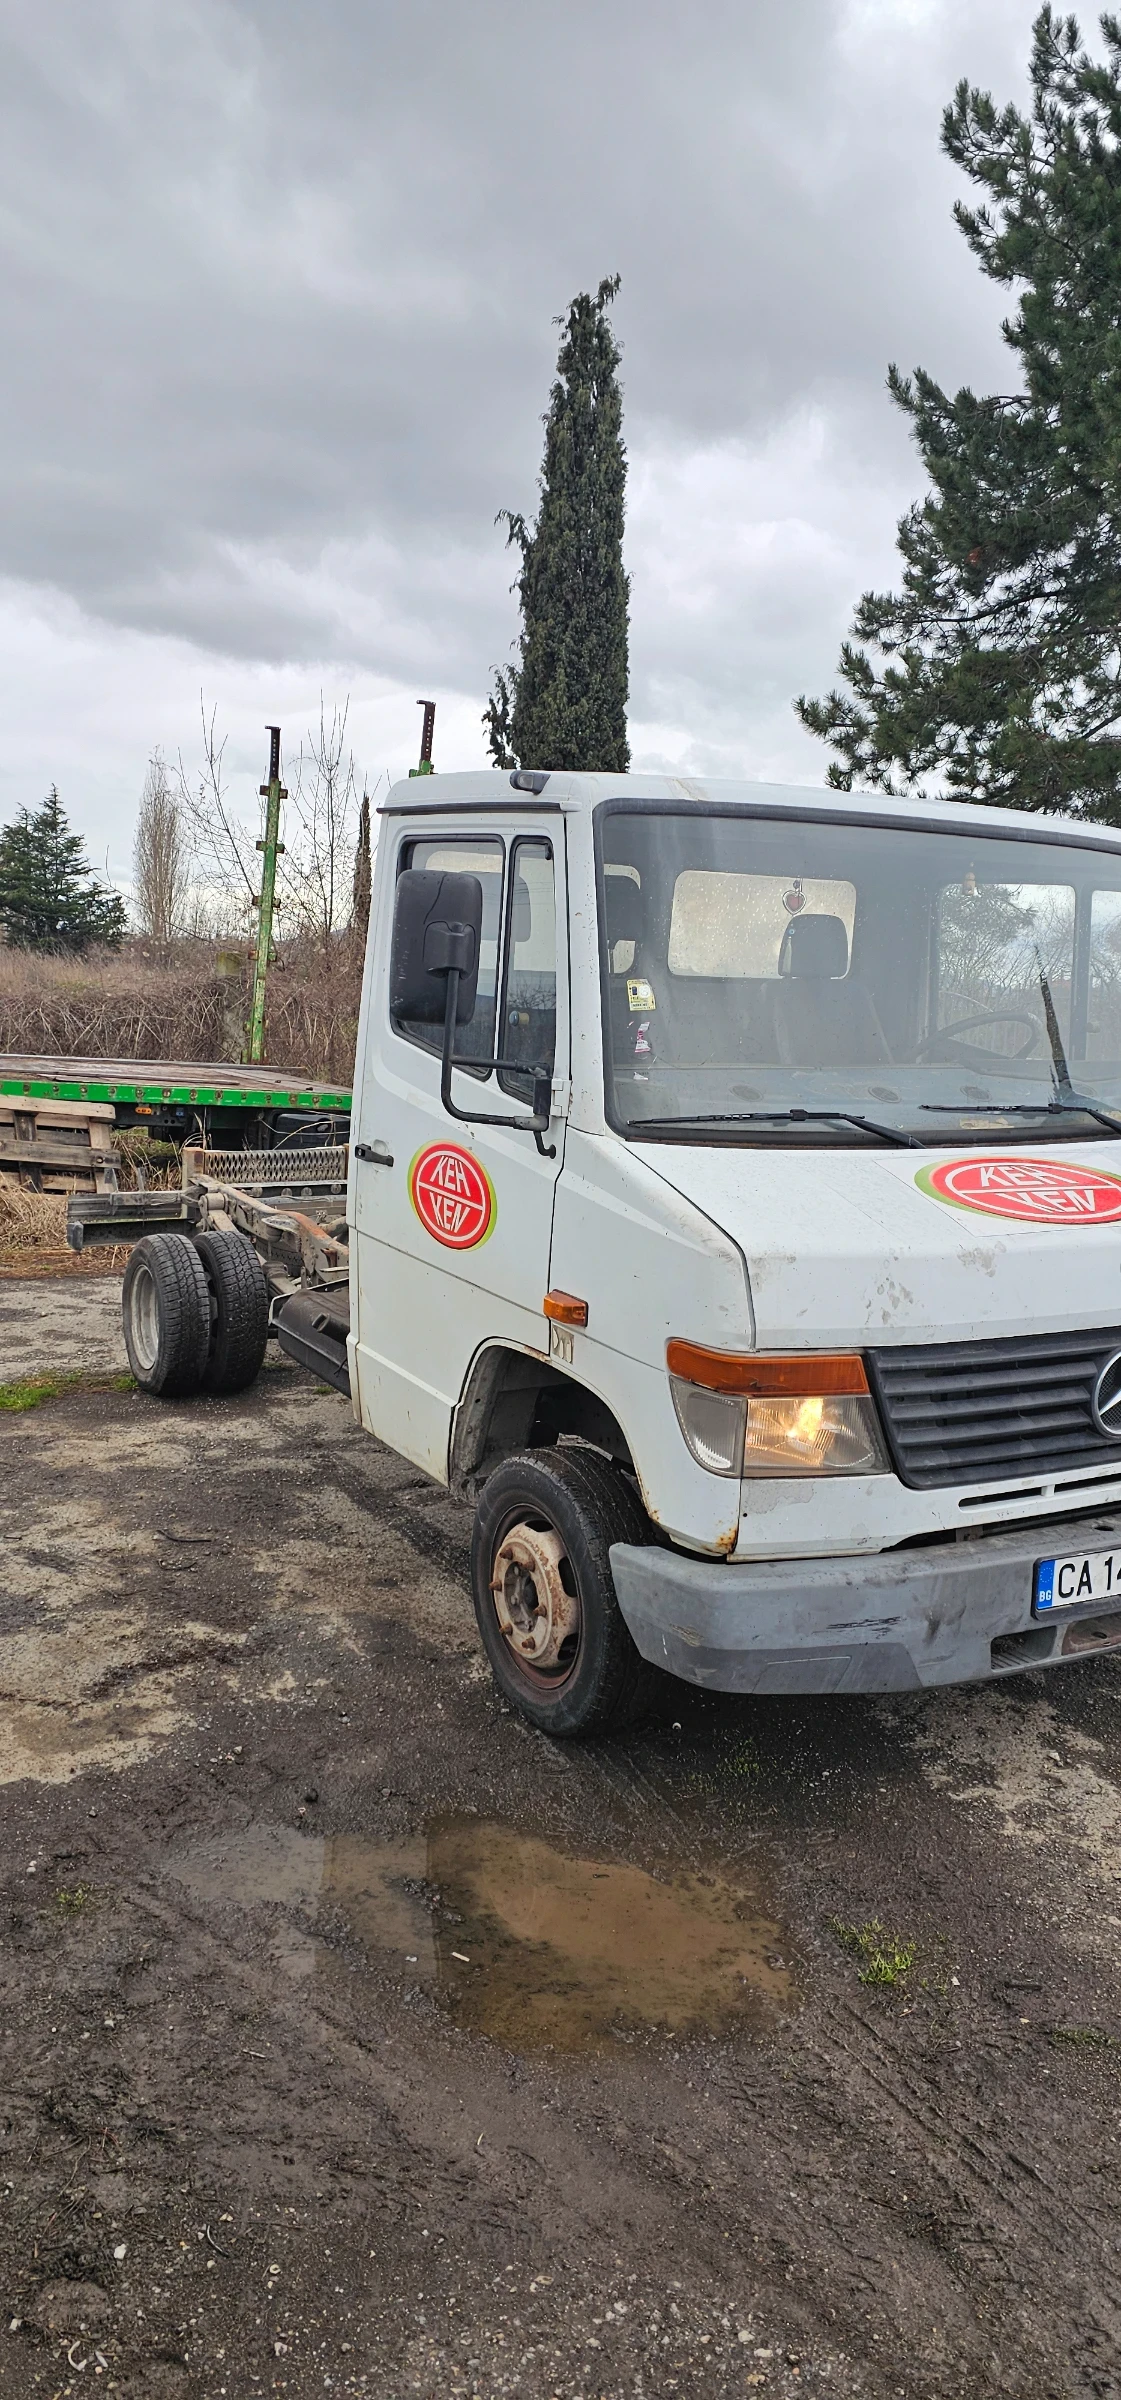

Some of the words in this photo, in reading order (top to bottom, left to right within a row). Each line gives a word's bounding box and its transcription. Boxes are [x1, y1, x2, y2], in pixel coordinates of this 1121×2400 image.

[429, 1191, 471, 1233] KEN
[995, 1189, 1097, 1214] KEN
[1058, 1560, 1092, 1598] CA
[1039, 1589, 1052, 1603] BG
